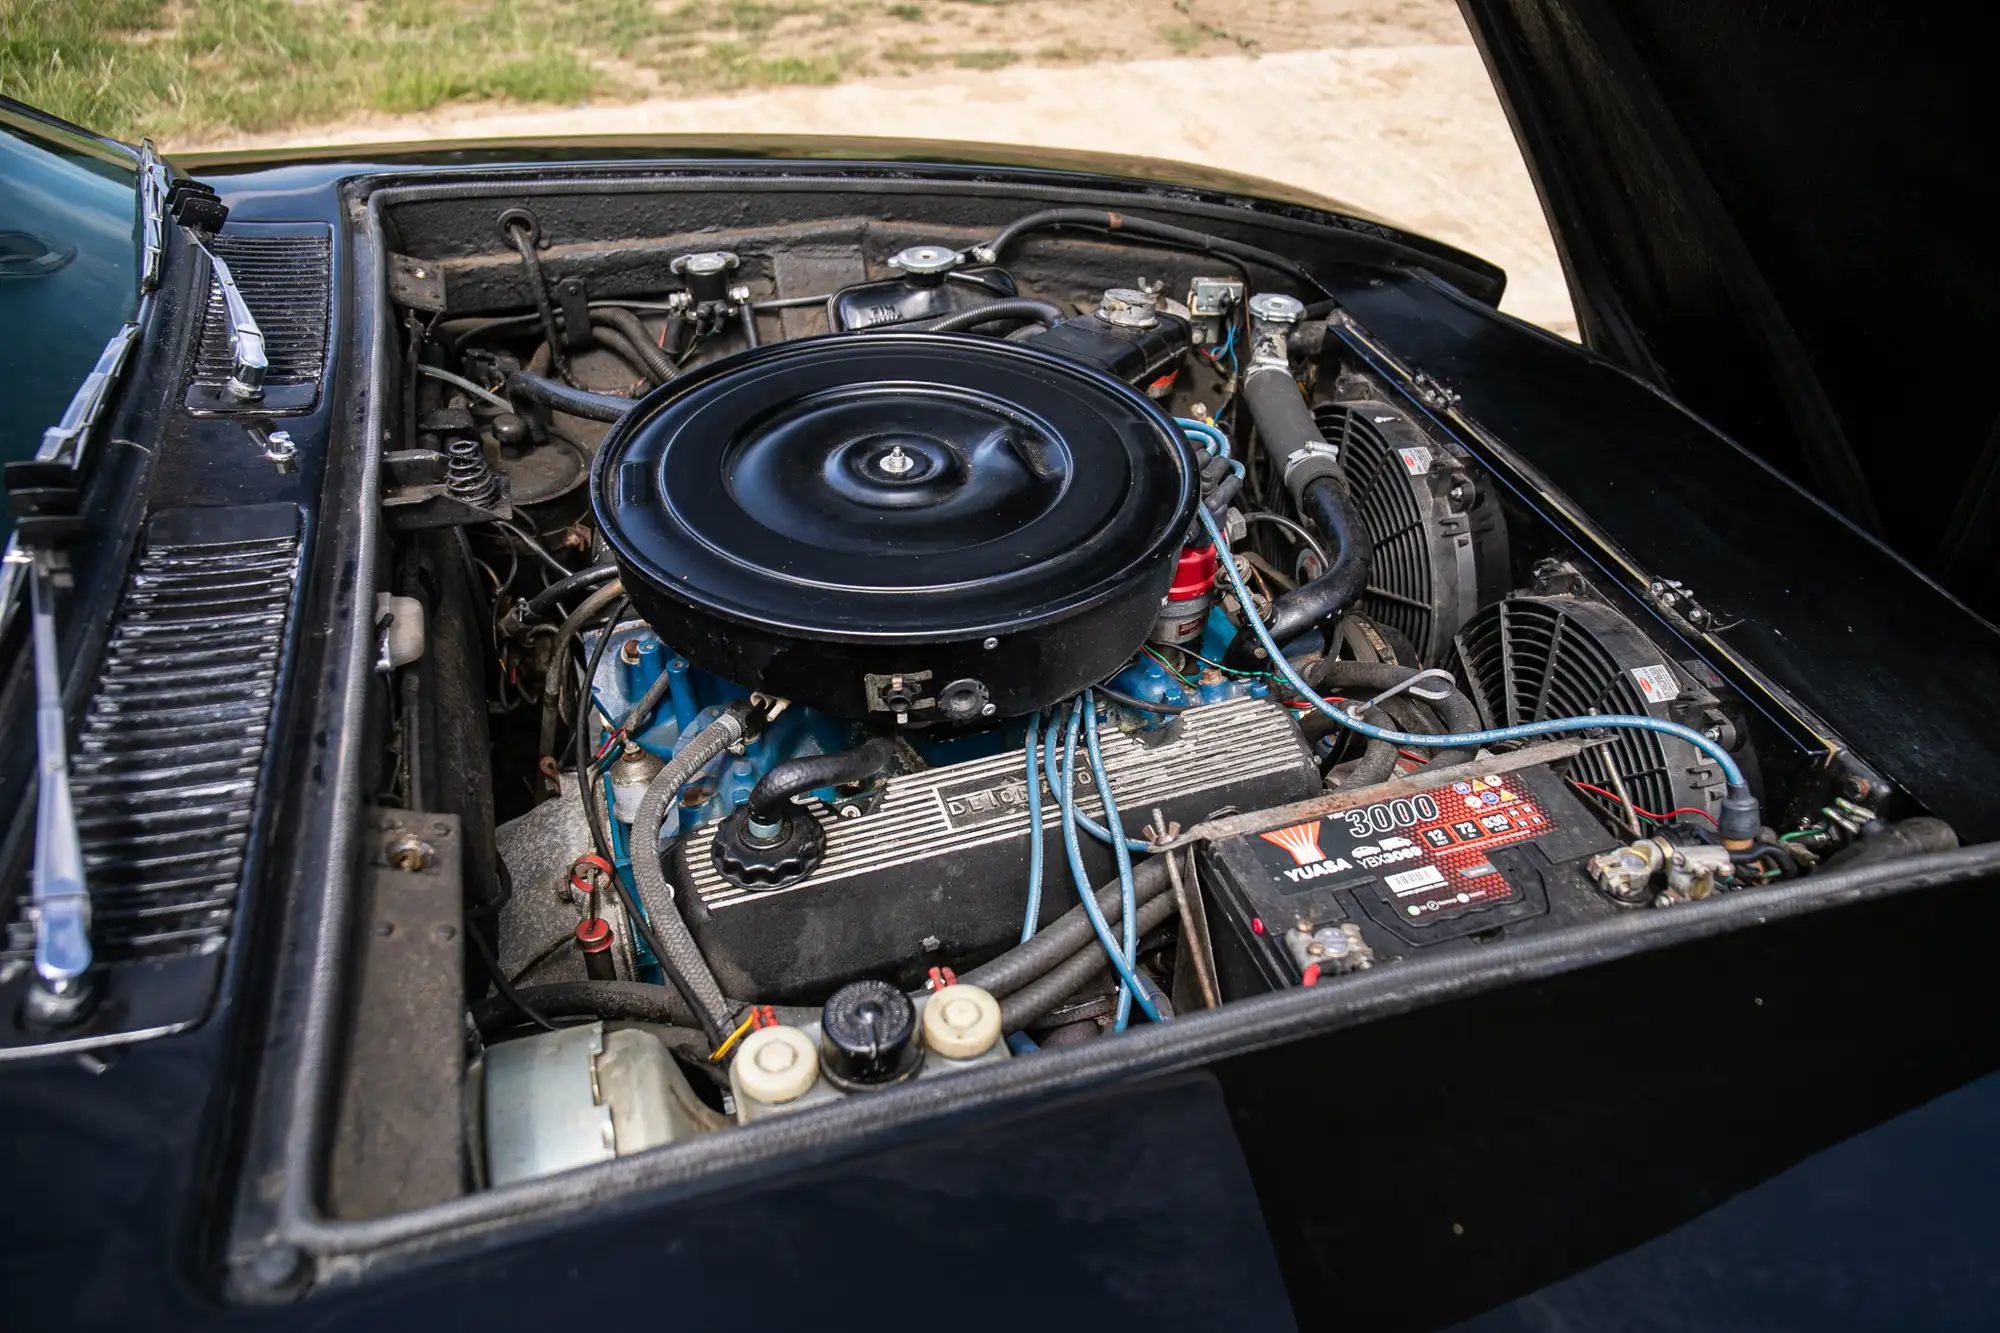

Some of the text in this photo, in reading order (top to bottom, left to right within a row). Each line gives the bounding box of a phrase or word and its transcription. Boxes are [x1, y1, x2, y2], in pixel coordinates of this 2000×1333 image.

[1345, 794, 1439, 838] 3000
[1427, 829, 1446, 841] 12
[1455, 821, 1477, 835] 72
[1284, 857, 1353, 883] YUASA
